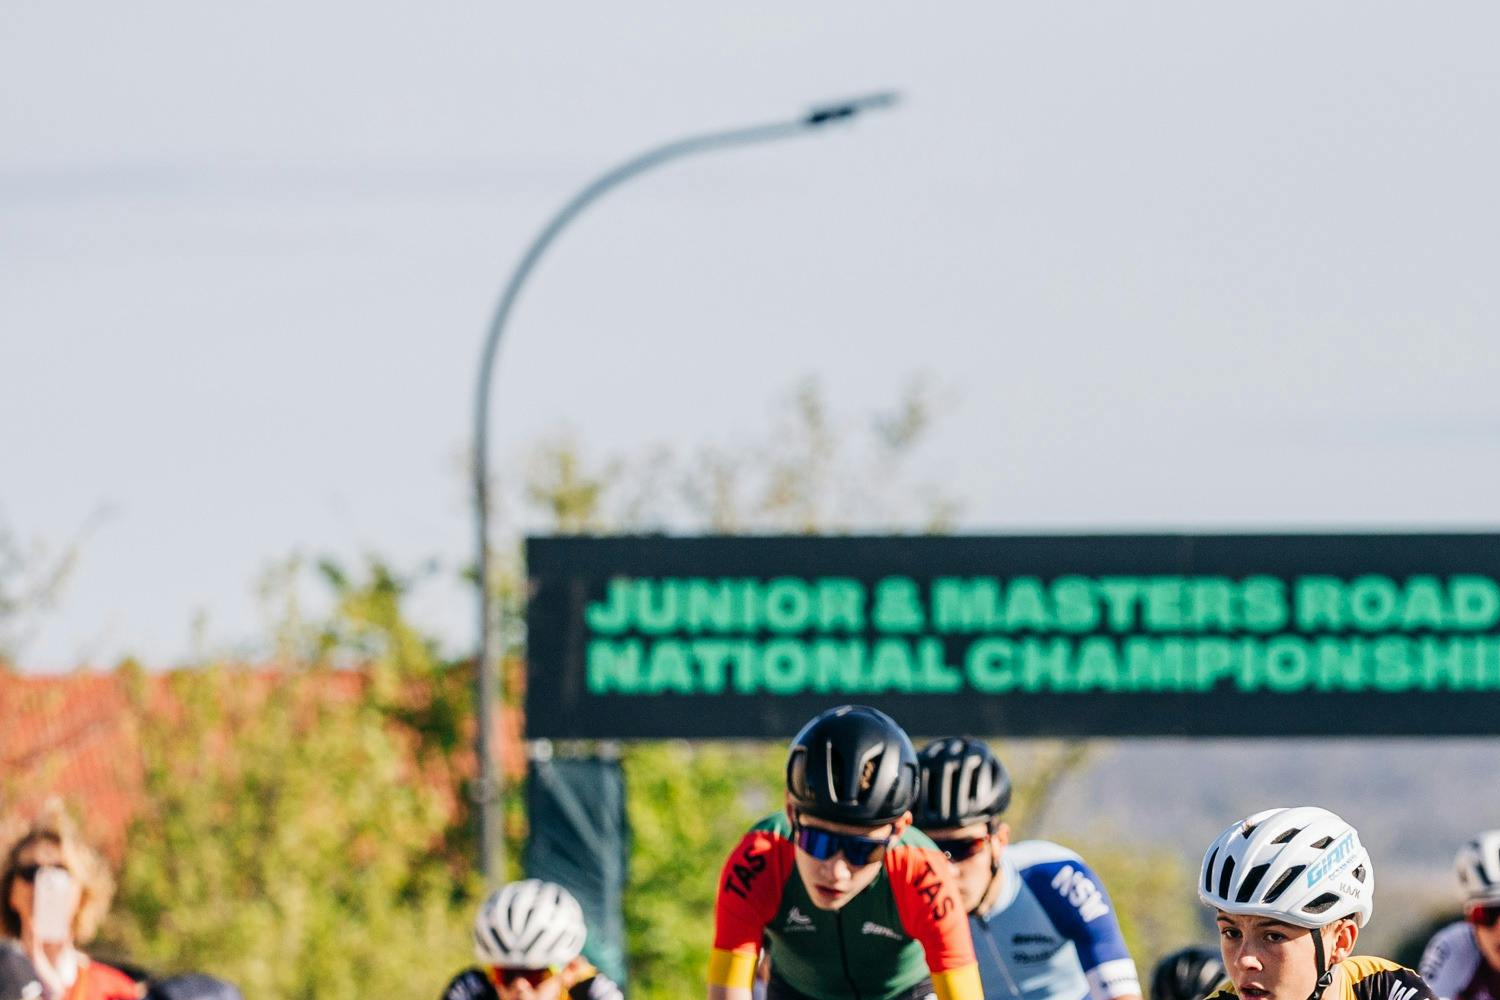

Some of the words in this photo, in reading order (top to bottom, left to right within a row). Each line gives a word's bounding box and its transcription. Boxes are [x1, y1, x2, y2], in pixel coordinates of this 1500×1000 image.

[585, 576, 866, 634] JUNIOR
[871, 575, 926, 634] &
[930, 575, 1291, 634] MASTERS
[585, 635, 963, 695] NATIONAL
[724, 847, 767, 899] TAS
[912, 862, 955, 922] TAS
[1051, 864, 1109, 923] NSW
